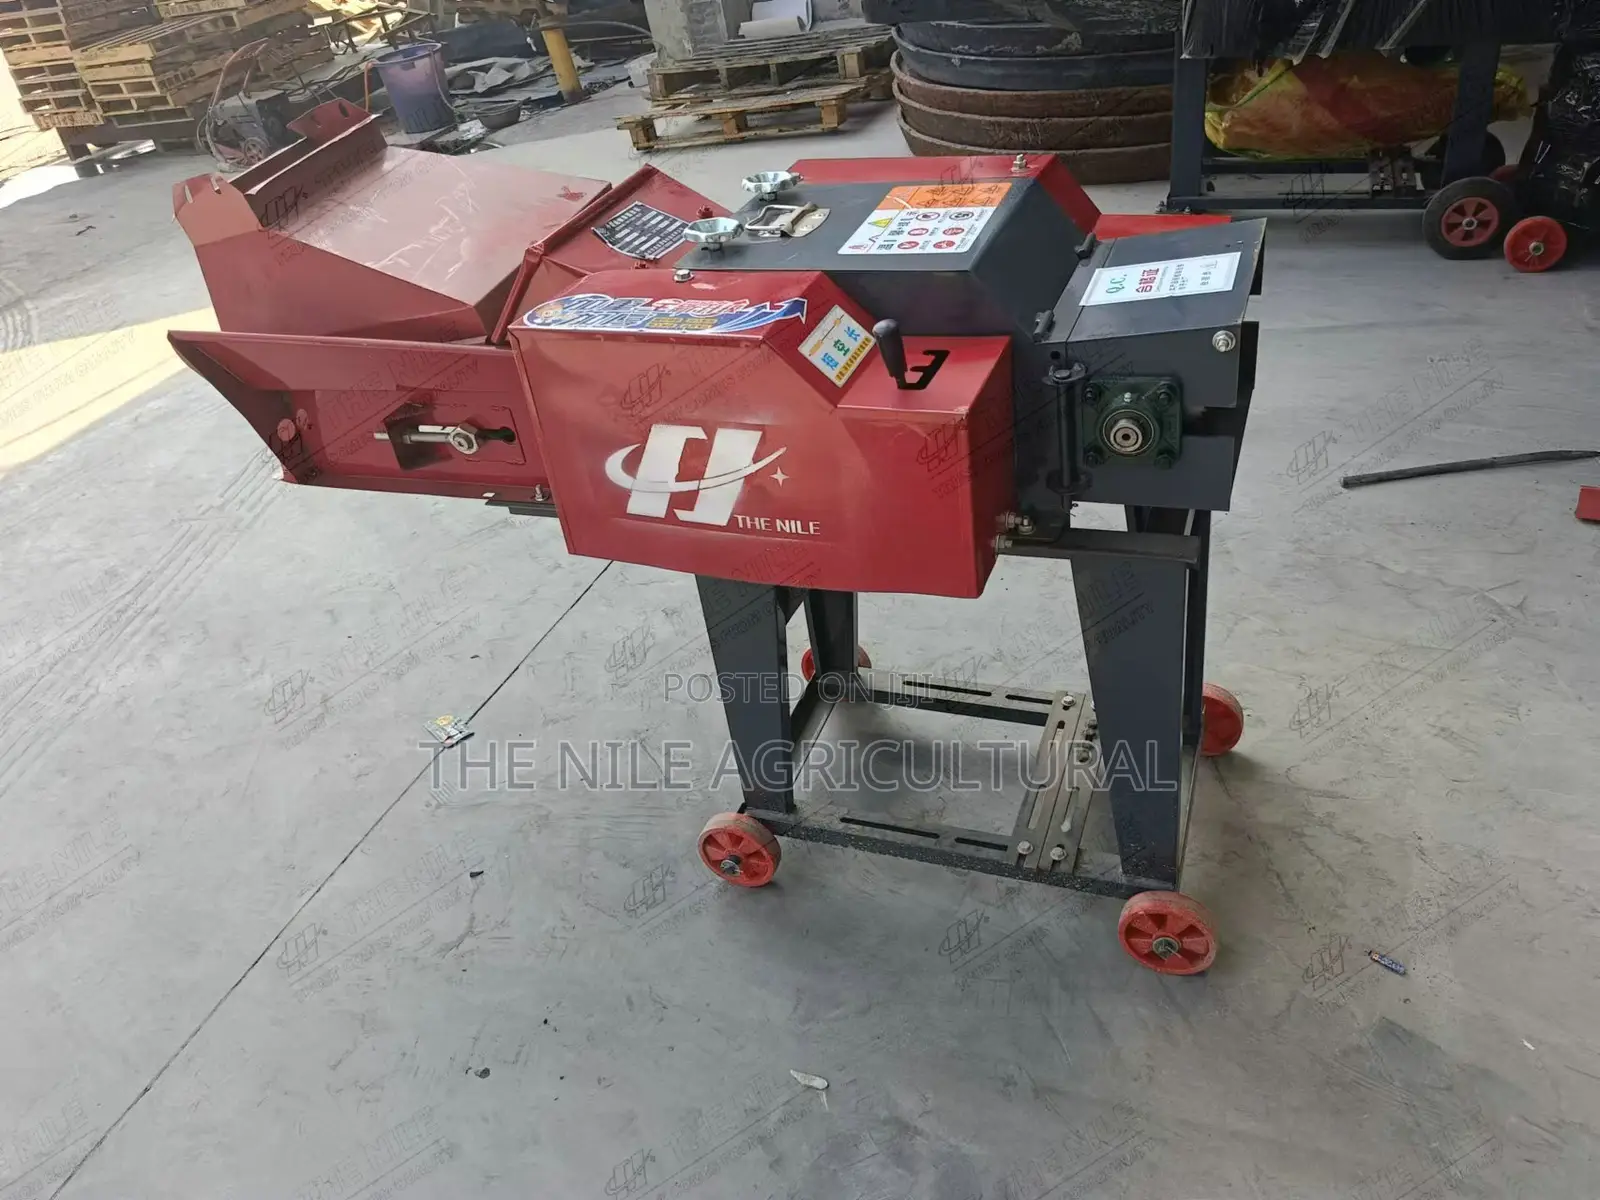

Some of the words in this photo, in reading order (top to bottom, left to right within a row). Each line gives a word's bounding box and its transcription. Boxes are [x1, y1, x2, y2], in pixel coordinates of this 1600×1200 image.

[1105, 273, 1128, 294] Q.C.
[1135, 267, 1160, 294] 合格证
[733, 514, 772, 532] THE
[776, 519, 821, 536] NILE
